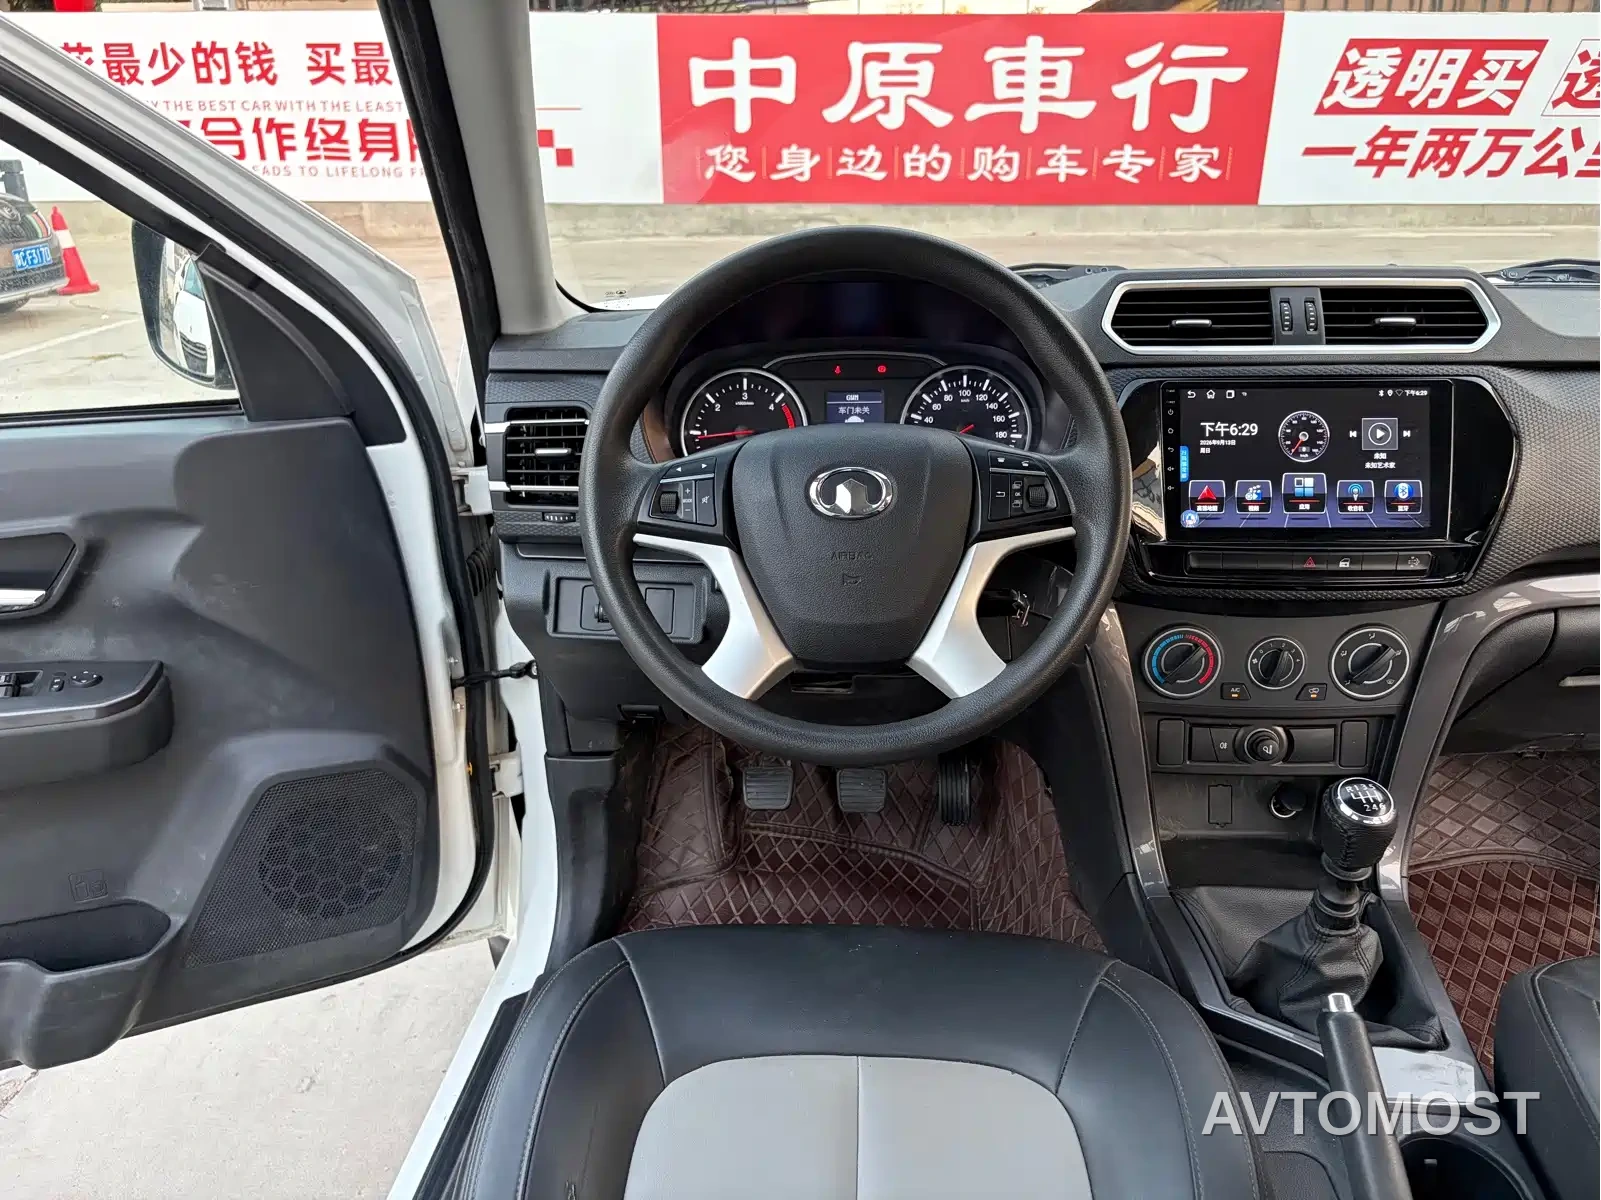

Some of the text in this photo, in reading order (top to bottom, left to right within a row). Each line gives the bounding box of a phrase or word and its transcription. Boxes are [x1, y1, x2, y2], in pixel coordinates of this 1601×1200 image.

[1322, 47, 1540, 109] 透明买
[688, 36, 1248, 133] 中原車行
[164, 100, 194, 111] THE
[198, 100, 237, 112] BEST
[240, 100, 271, 111] CAR
[275, 100, 317, 112] WITH
[320, 100, 352, 112] THE
[355, 100, 404, 112] LEAST
[704, 144, 1224, 184] 您身边的购车专家
[299, 166, 318, 176] TO
[325, 165, 402, 177] LIFELONG
[741, 392, 748, 401] 3
[958, 389, 971, 397] 100
[975, 393, 988, 401] 120
[943, 394, 953, 402] 80
[714, 403, 721, 412] 2
[768, 403, 775, 411] 4
[932, 403, 942, 411] 60
[985, 402, 998, 410] 140
[838, 406, 870, 415] 车门未关
[923, 416, 934, 424] 40
[992, 415, 1006, 423] 160
[1200, 421, 1259, 437] 下午6:29
[995, 431, 1008, 439] 180
[1361, 783, 1368, 791] 3
[1363, 804, 1372, 812] 2
[1372, 803, 1378, 811] 4
